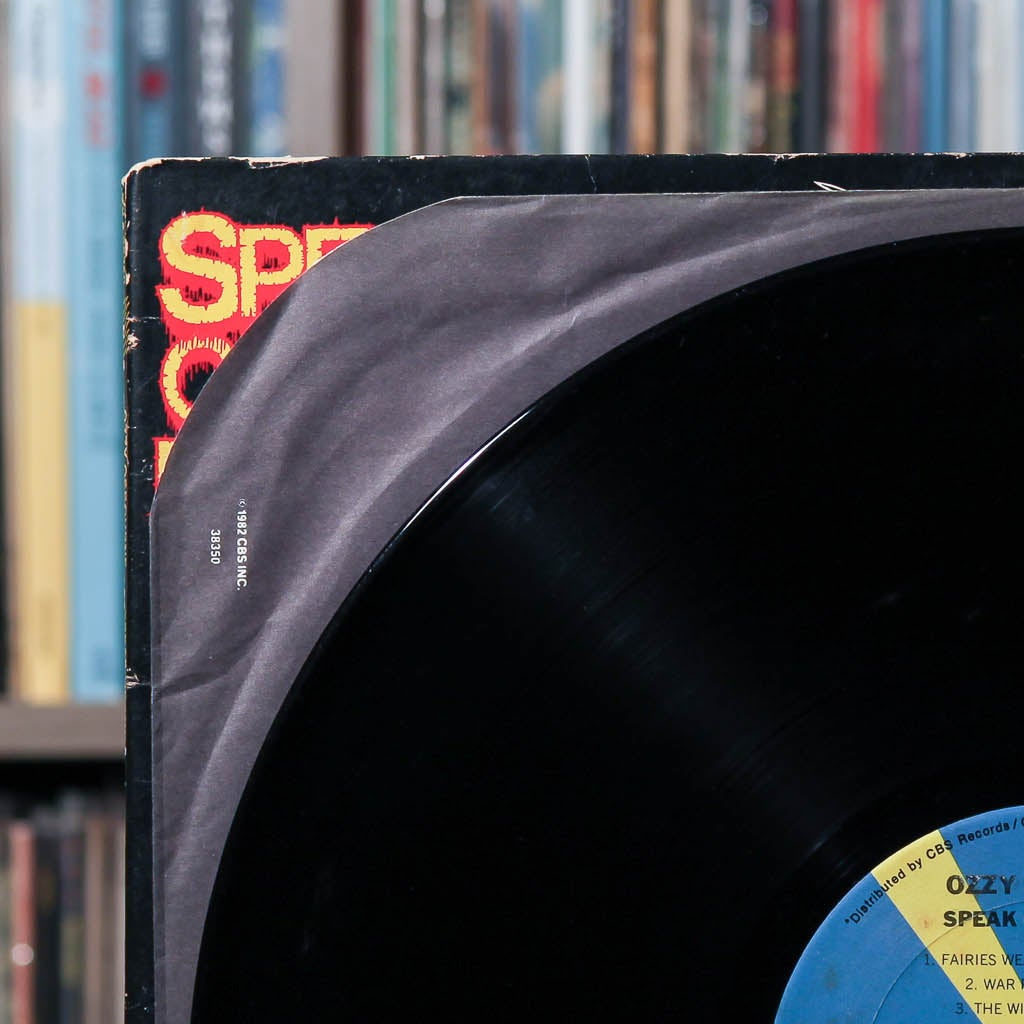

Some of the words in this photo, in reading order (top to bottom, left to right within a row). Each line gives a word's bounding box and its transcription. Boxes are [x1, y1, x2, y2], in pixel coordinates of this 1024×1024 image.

[237, 509, 247, 535] 1982
[210, 529, 221, 565] 38350
[237, 538, 248, 563] CBS
[236, 565, 248, 591] INC.
[908, 858, 923, 872] by
[926, 840, 953, 860] CBS
[946, 875, 1016, 895] OZZY
[943, 911, 1017, 928] SPEAK
[924, 954, 935, 966] 1.
[942, 954, 996, 966] FAIRIES
[965, 978, 977, 990] 2.
[984, 978, 1015, 990] WAR
[955, 1003, 968, 1015] 3.
[974, 1003, 1002, 1015] THE
